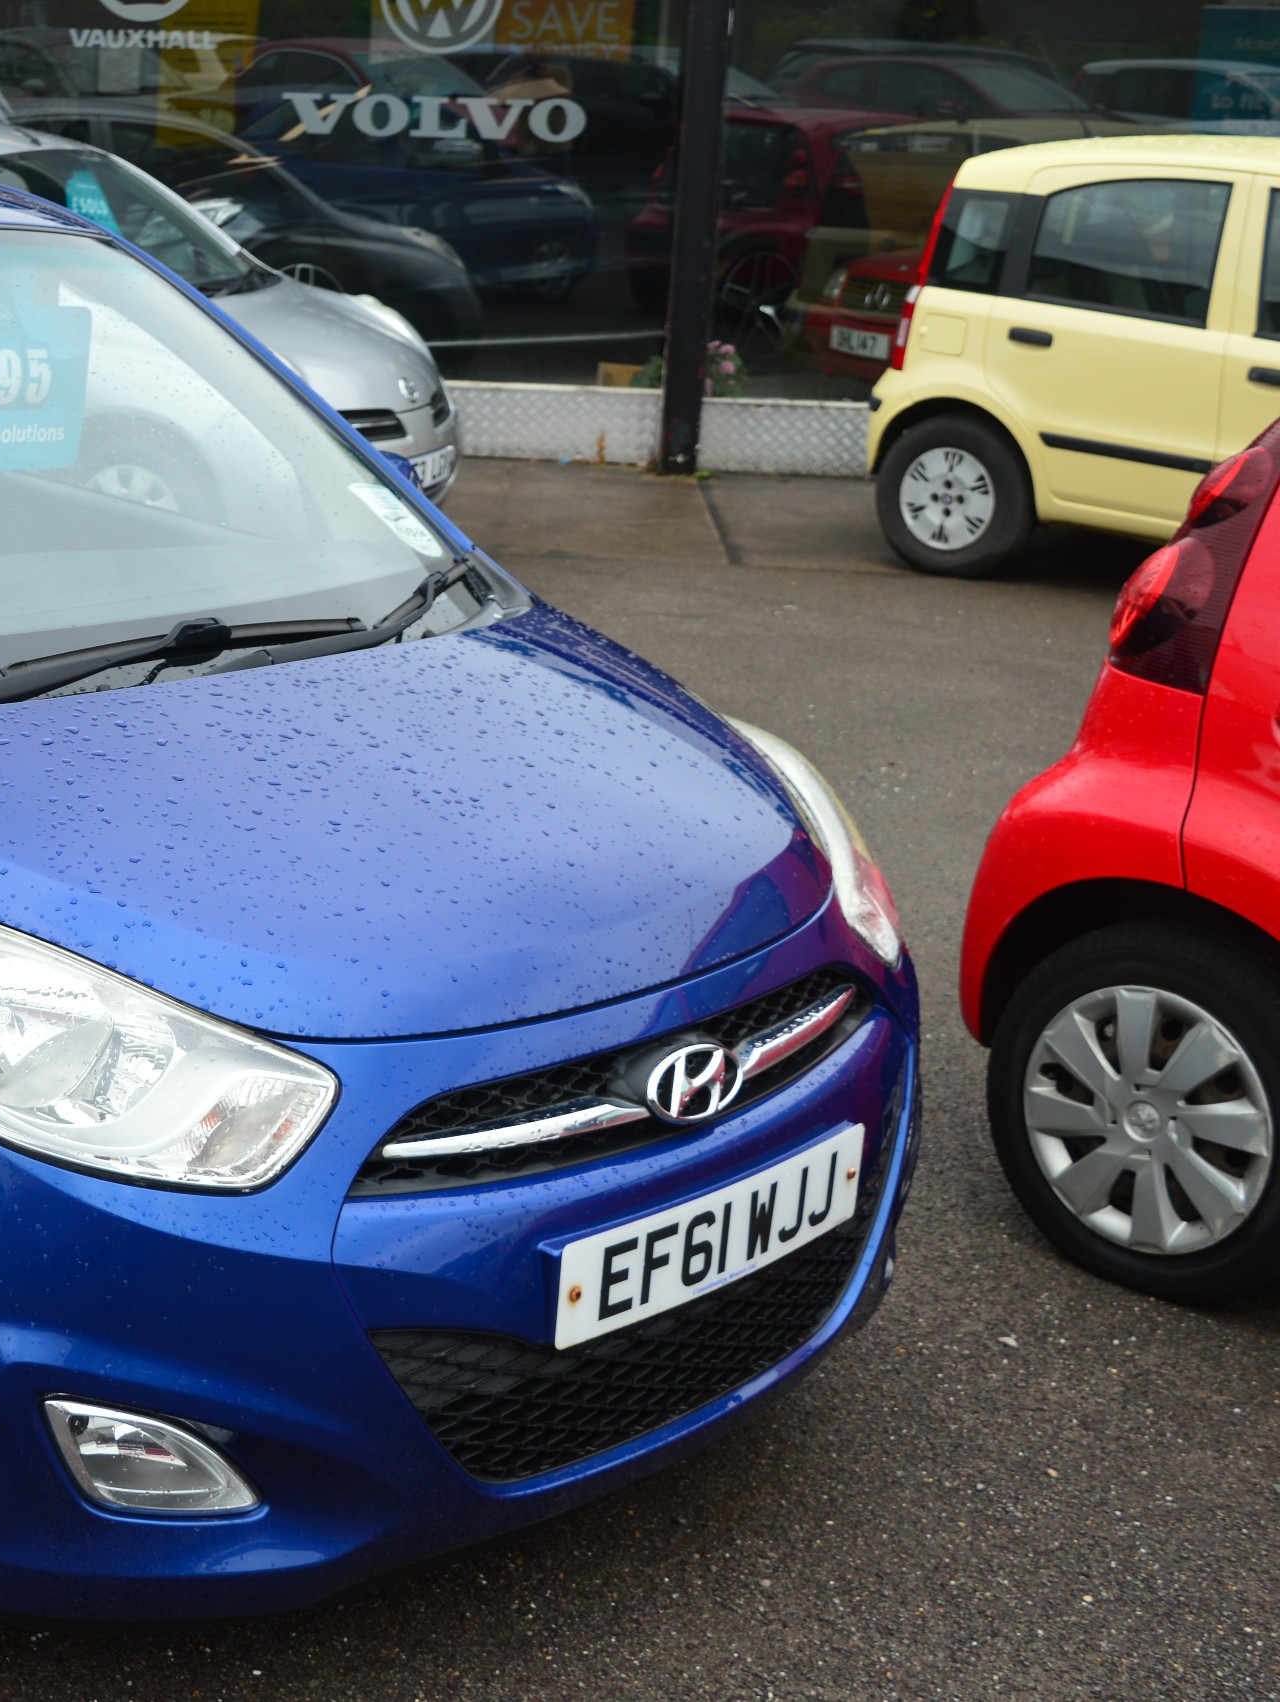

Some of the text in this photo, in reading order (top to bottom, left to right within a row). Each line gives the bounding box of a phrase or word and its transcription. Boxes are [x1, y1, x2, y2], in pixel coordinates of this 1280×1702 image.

[68, 28, 218, 50] VAUXHALL
[511, 2, 619, 40] SAVE
[281, 92, 587, 143] VOLVO
[598, 1150, 839, 1321] EF61 WJJ
